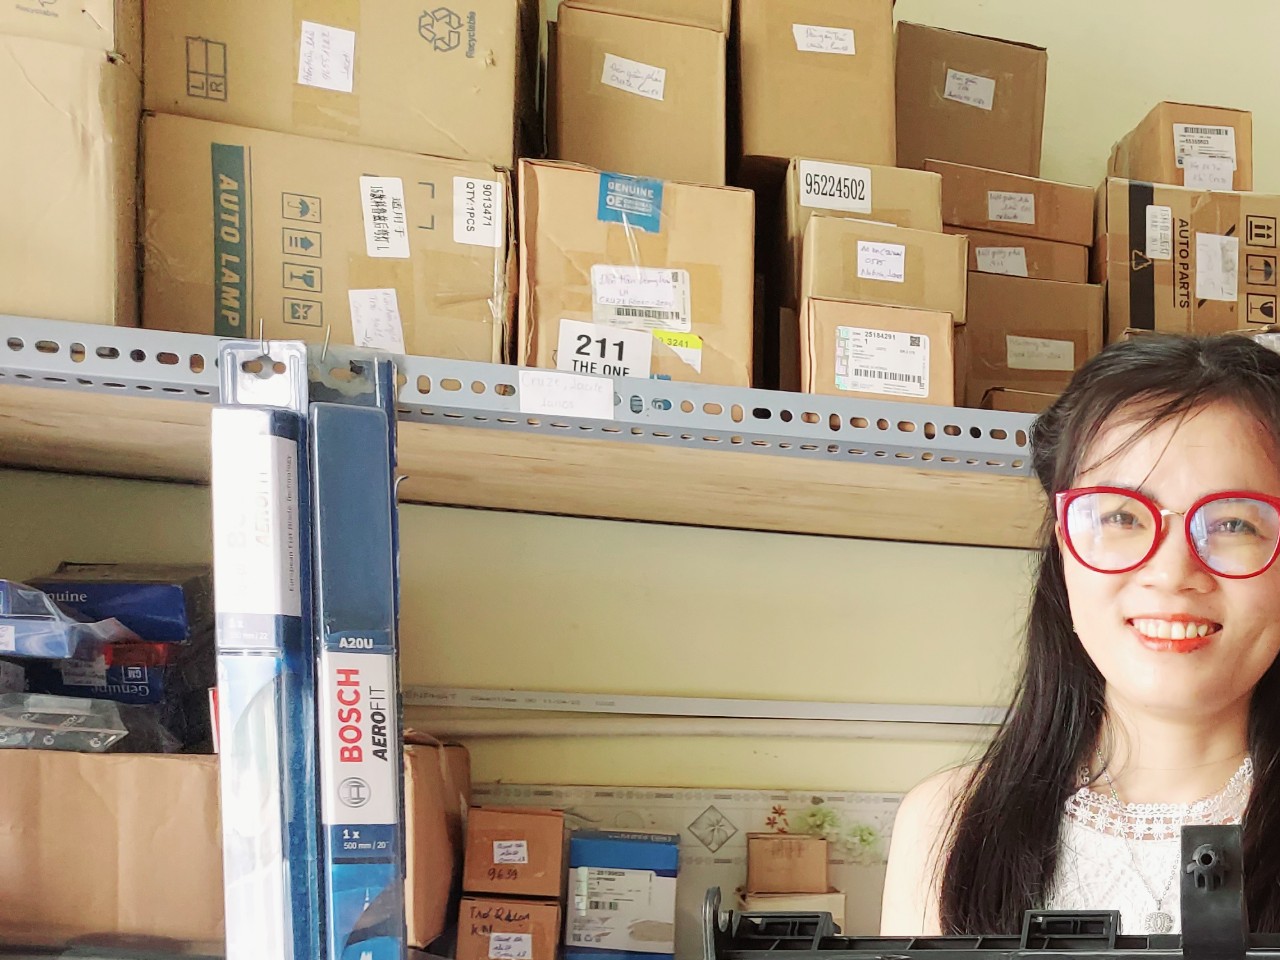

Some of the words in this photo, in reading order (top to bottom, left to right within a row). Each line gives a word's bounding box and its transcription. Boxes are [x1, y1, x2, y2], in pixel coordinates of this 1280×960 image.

[210, 81, 224, 93] R
[606, 194, 623, 207] OE
[607, 180, 655, 199] GENUINE
[804, 172, 866, 201] 95224502
[219, 173, 240, 244] AUTO
[465, 181, 477, 233] QTY:1PCS
[481, 184, 494, 228] 9013471
[1178, 218, 1191, 260] AUTO
[219, 253, 240, 328] LAMP
[1178, 263, 1191, 310] PARTS
[575, 333, 626, 362] 211
[571, 359, 598, 375] THE
[602, 363, 631, 377] ONE
[339, 637, 374, 649] A20U
[335, 668, 364, 763] BOSCH
[368, 685, 389, 762] AEROFIT
[342, 829, 349, 839] 1
[343, 841, 357, 850] 500
[358, 841, 371, 850] mm
